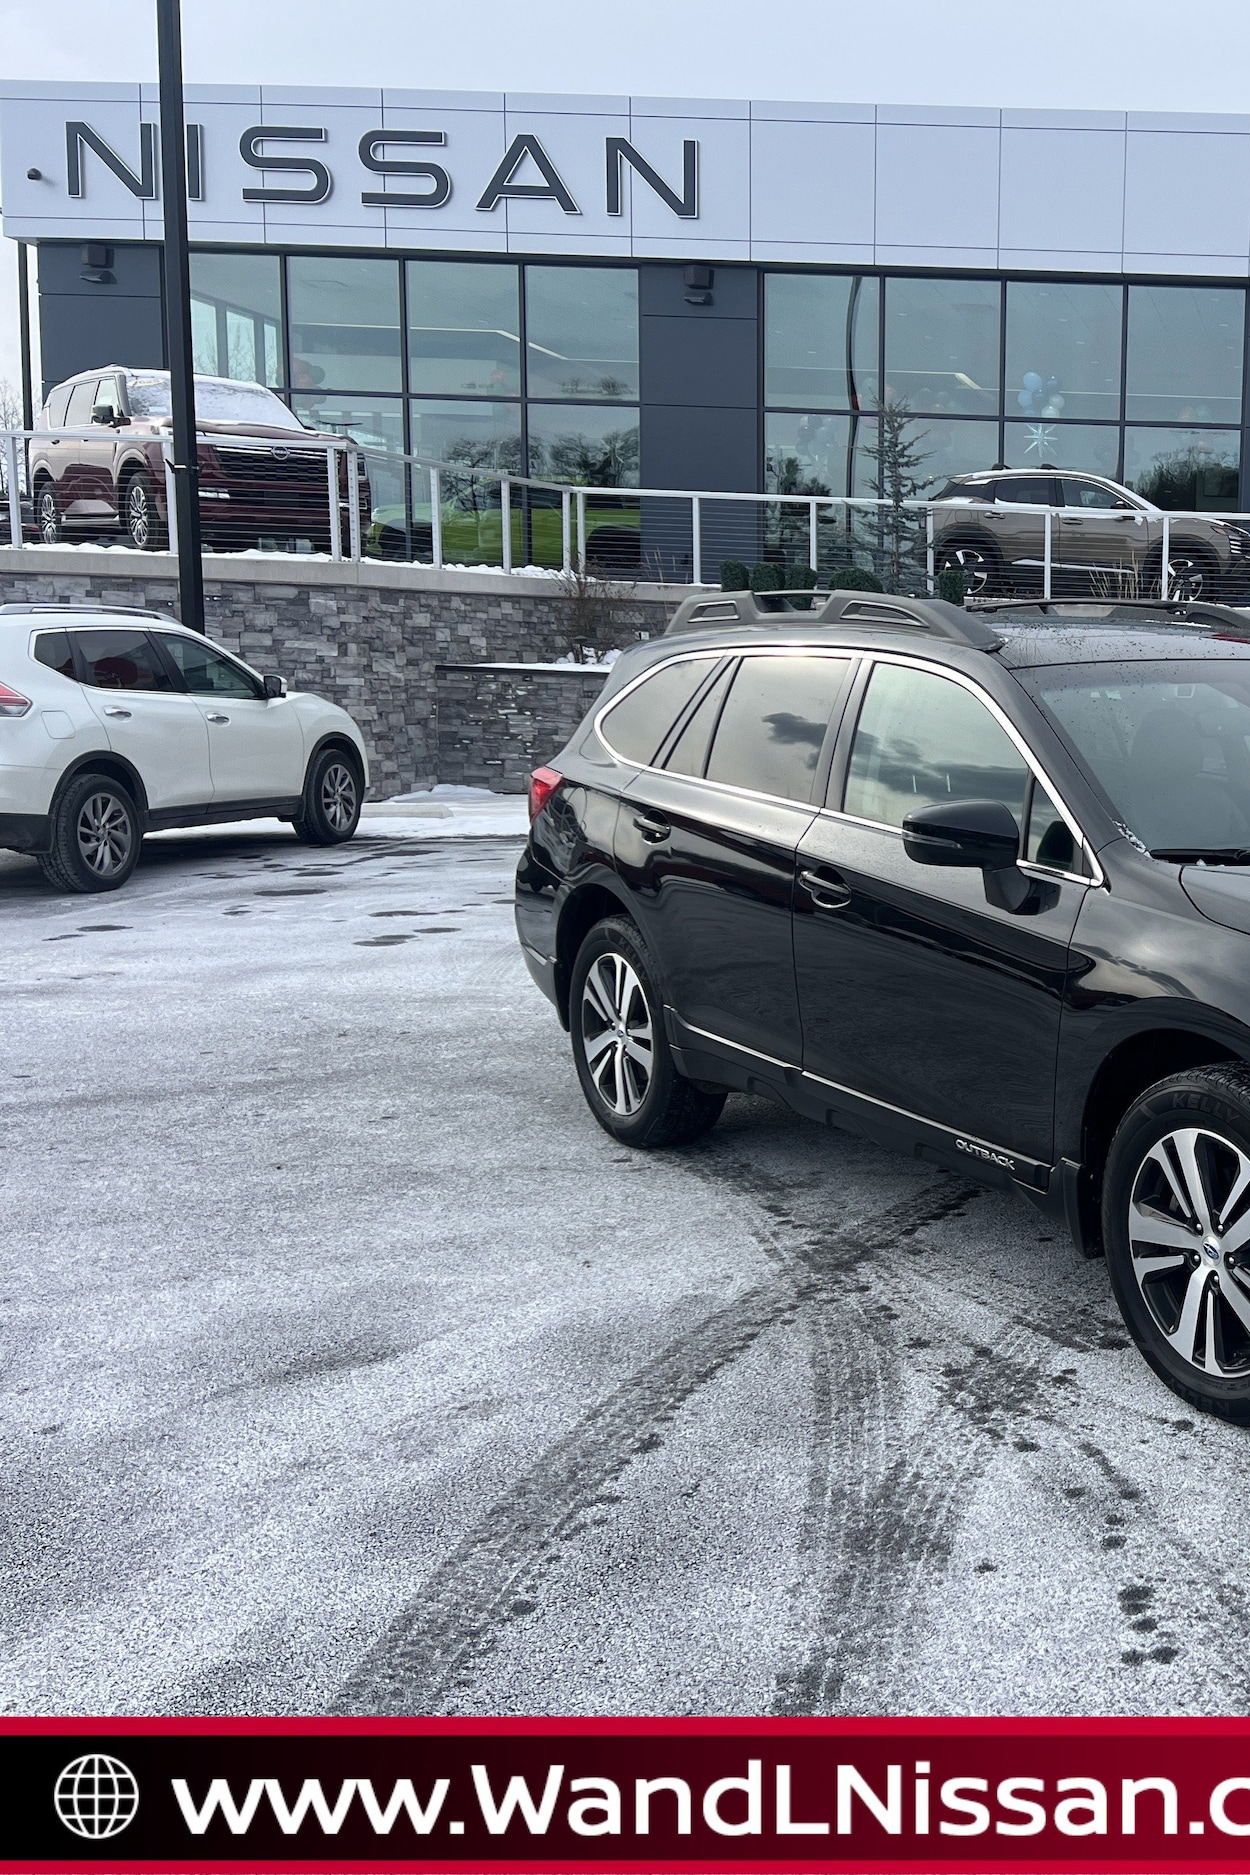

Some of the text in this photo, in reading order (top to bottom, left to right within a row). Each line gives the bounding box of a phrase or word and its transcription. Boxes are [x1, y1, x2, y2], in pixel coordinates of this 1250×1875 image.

[65, 120, 699, 219] NISSAN
[1172, 1093, 1241, 1123] KELLY
[955, 1138, 1016, 1170] OUTBACK
